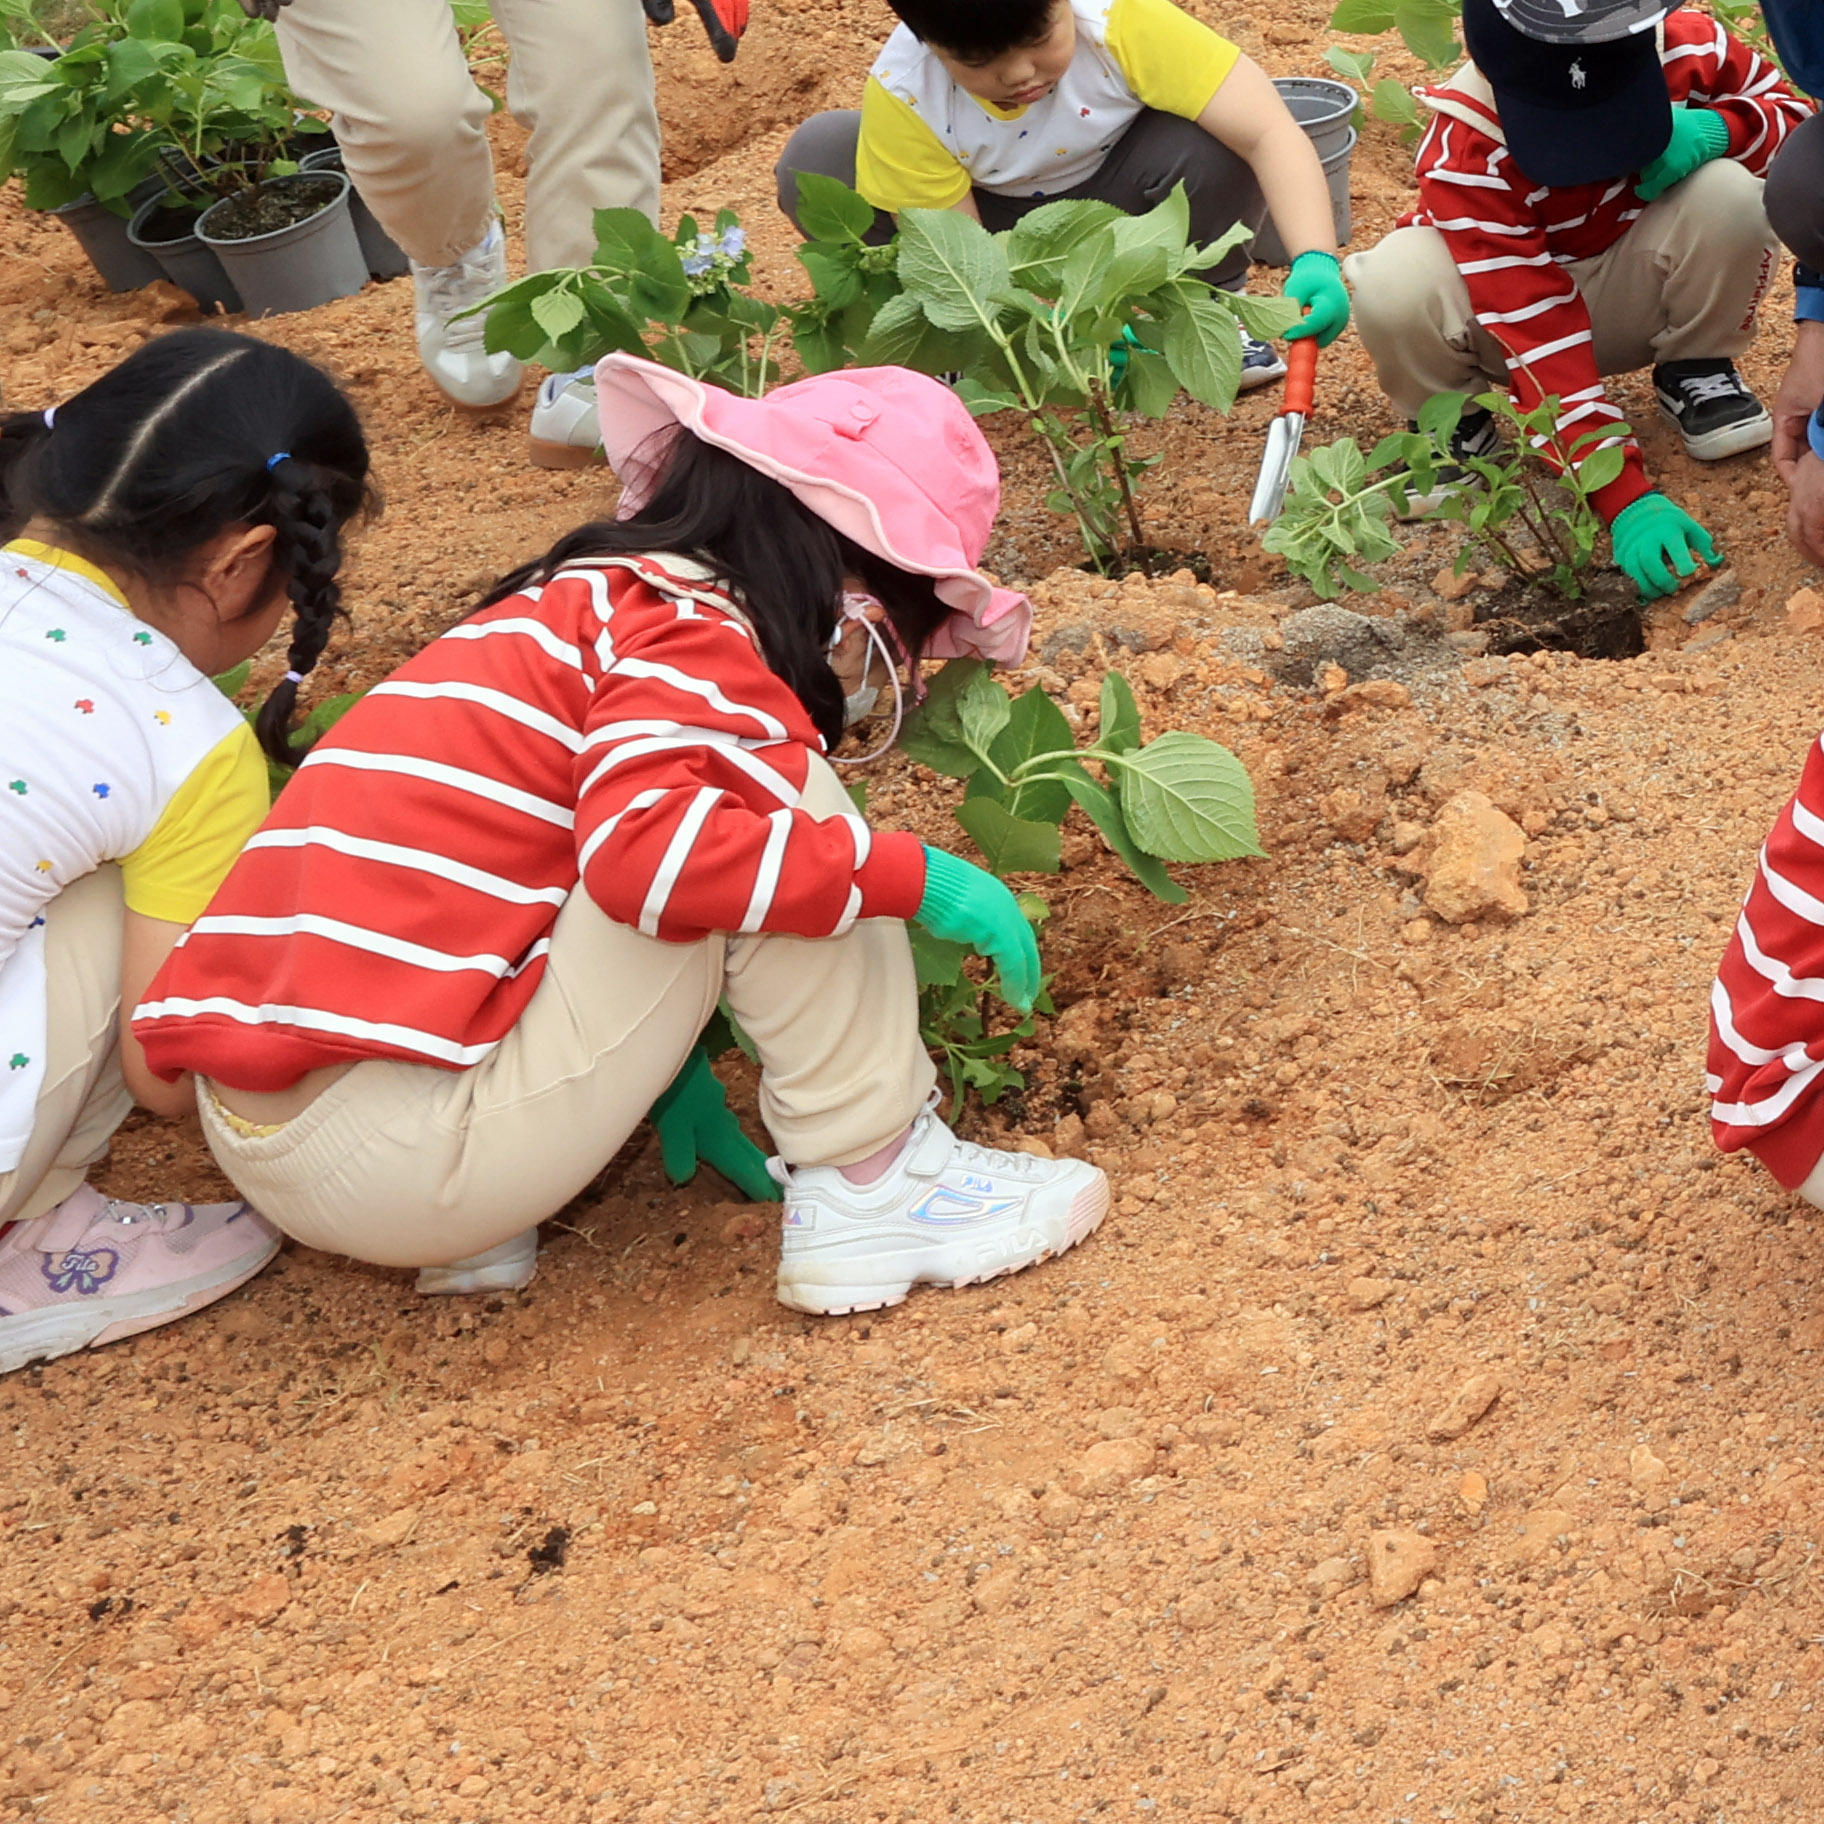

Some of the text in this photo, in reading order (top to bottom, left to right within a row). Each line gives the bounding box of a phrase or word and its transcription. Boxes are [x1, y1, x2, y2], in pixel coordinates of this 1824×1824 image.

[960, 1175, 993, 1193] FILA
[974, 1228, 1050, 1264] FILA
[61, 1254, 98, 1272] Fila
